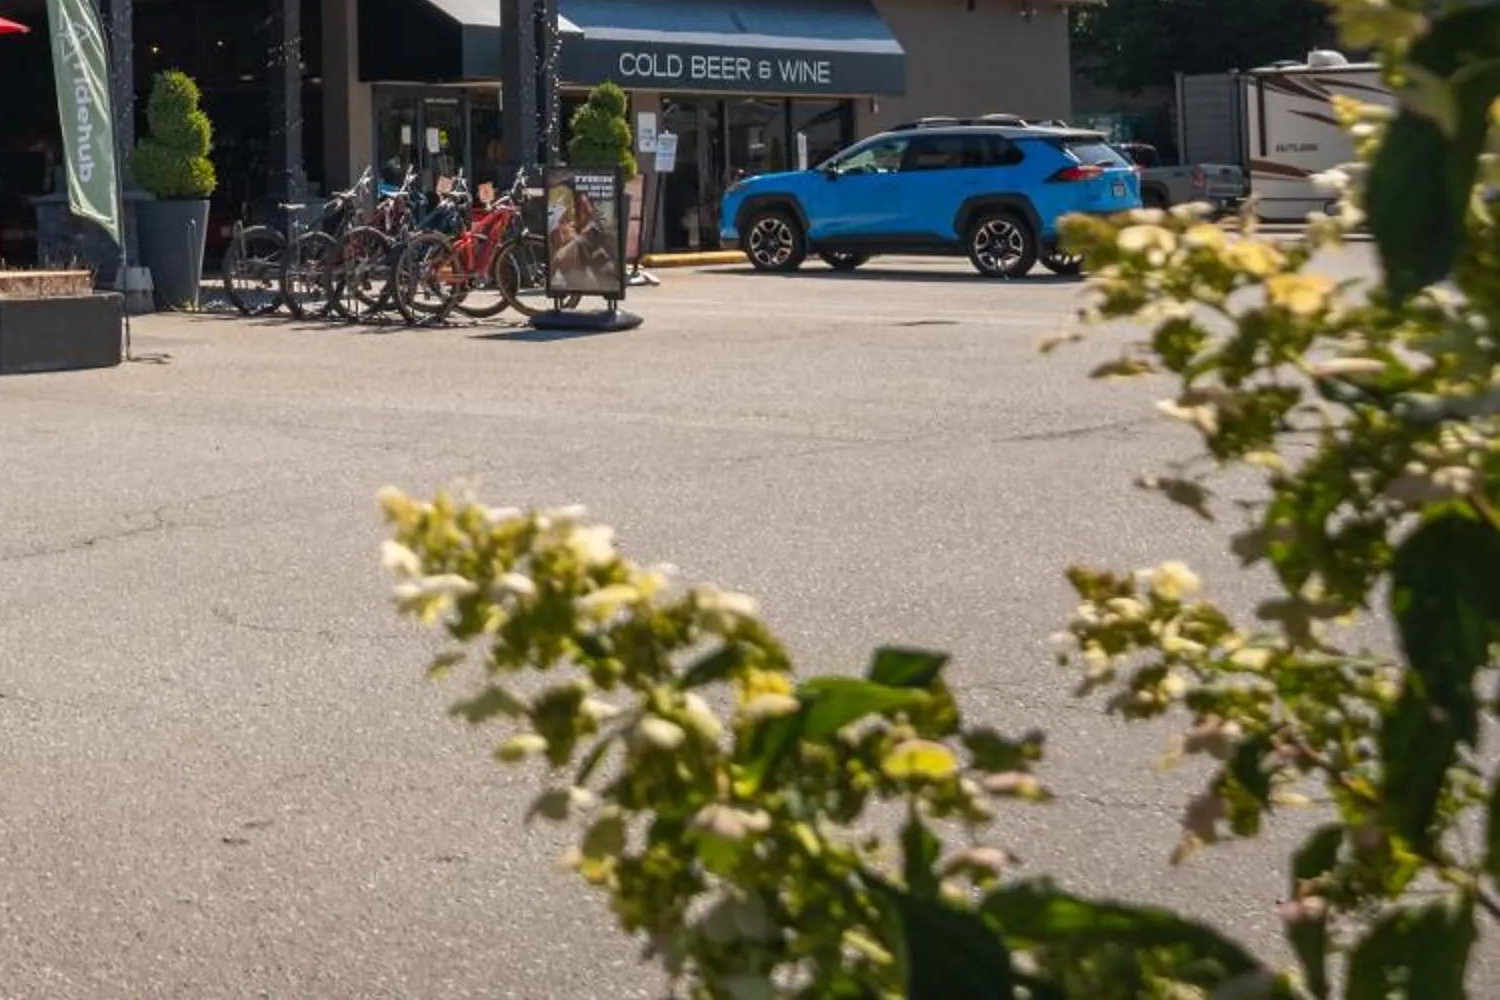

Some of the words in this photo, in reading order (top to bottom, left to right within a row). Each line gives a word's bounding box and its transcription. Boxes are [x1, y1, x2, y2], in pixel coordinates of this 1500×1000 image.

[619, 53, 683, 77] COLD
[691, 55, 751, 80] BEER
[778, 60, 831, 83] WINE
